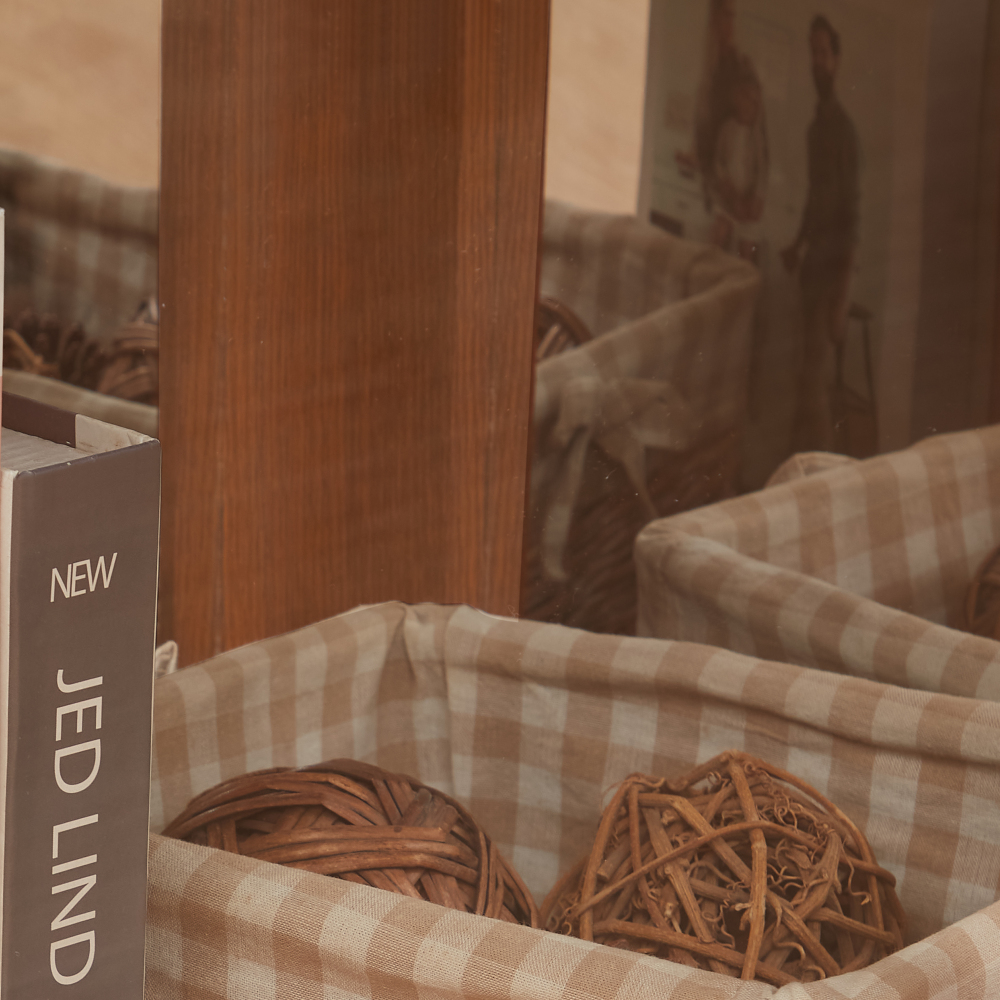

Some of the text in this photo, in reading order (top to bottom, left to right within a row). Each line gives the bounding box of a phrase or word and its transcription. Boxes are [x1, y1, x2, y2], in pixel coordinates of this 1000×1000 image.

[50, 552, 118, 603] NEW
[50, 669, 103, 986] JED LIND
